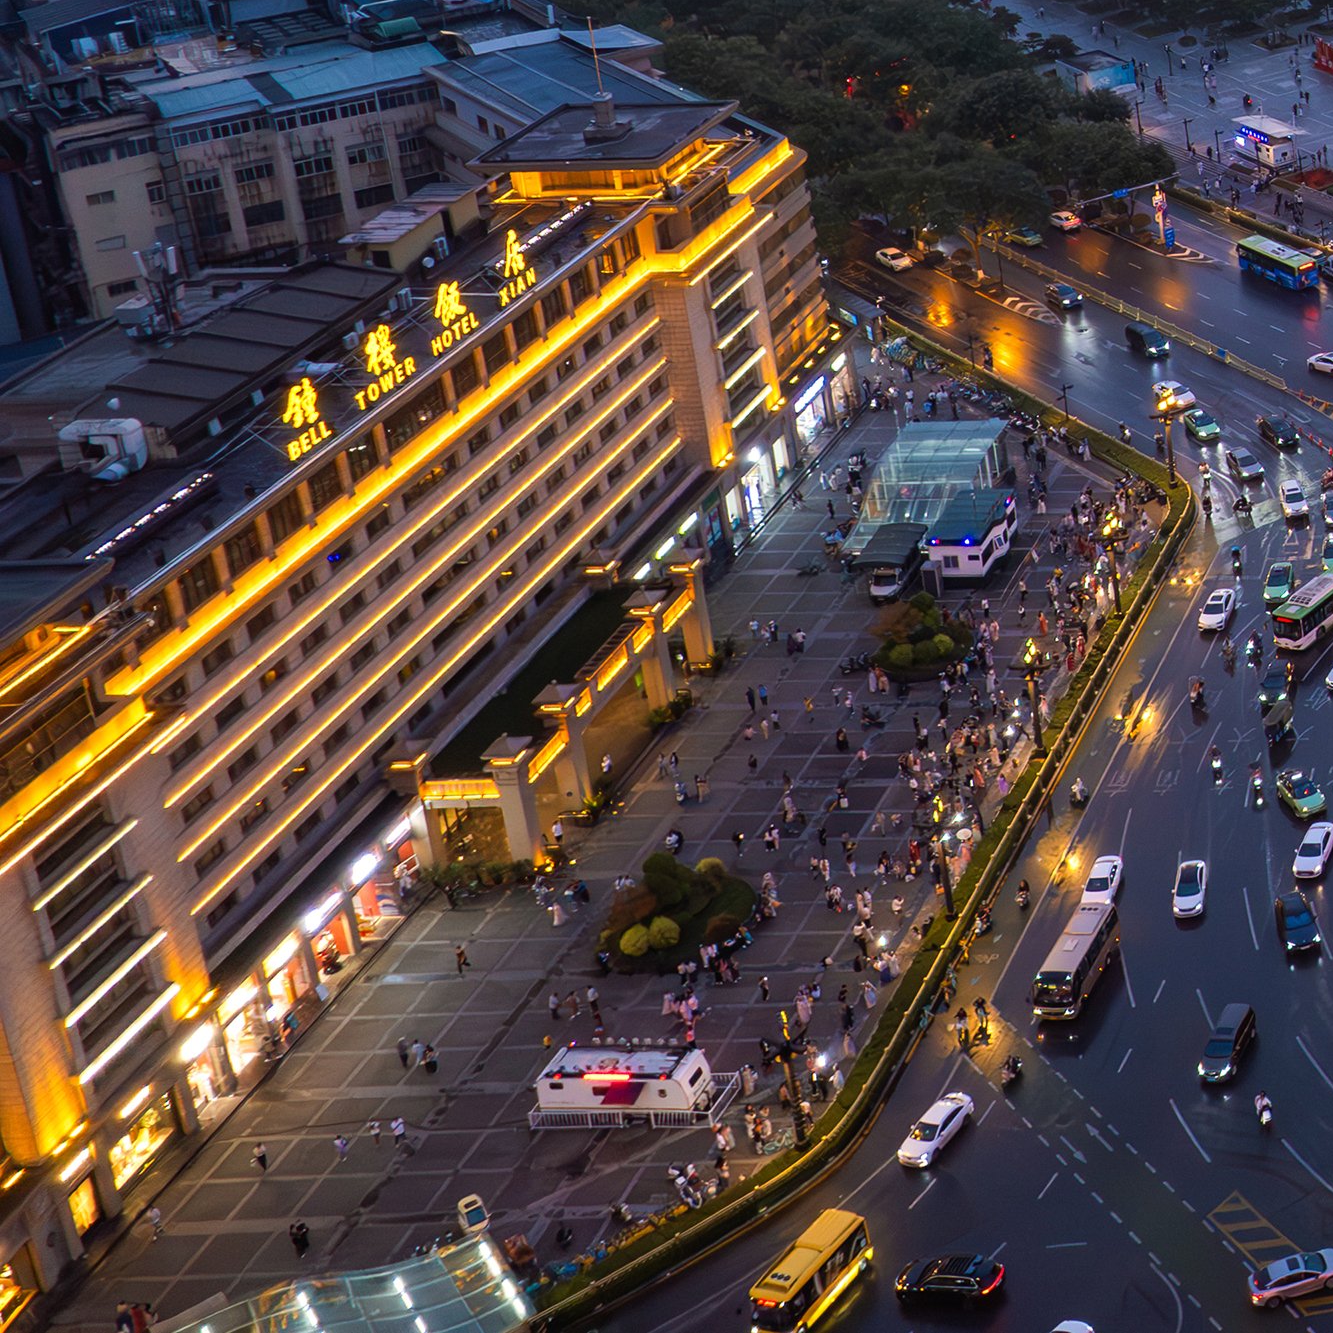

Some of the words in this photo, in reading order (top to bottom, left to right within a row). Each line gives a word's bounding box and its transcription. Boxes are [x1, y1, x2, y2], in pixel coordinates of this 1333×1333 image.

[286, 420, 332, 462] BELL
[353, 355, 417, 411] TOWER
[430, 311, 480, 357] HOTEL
[498, 266, 538, 307] XIAN
